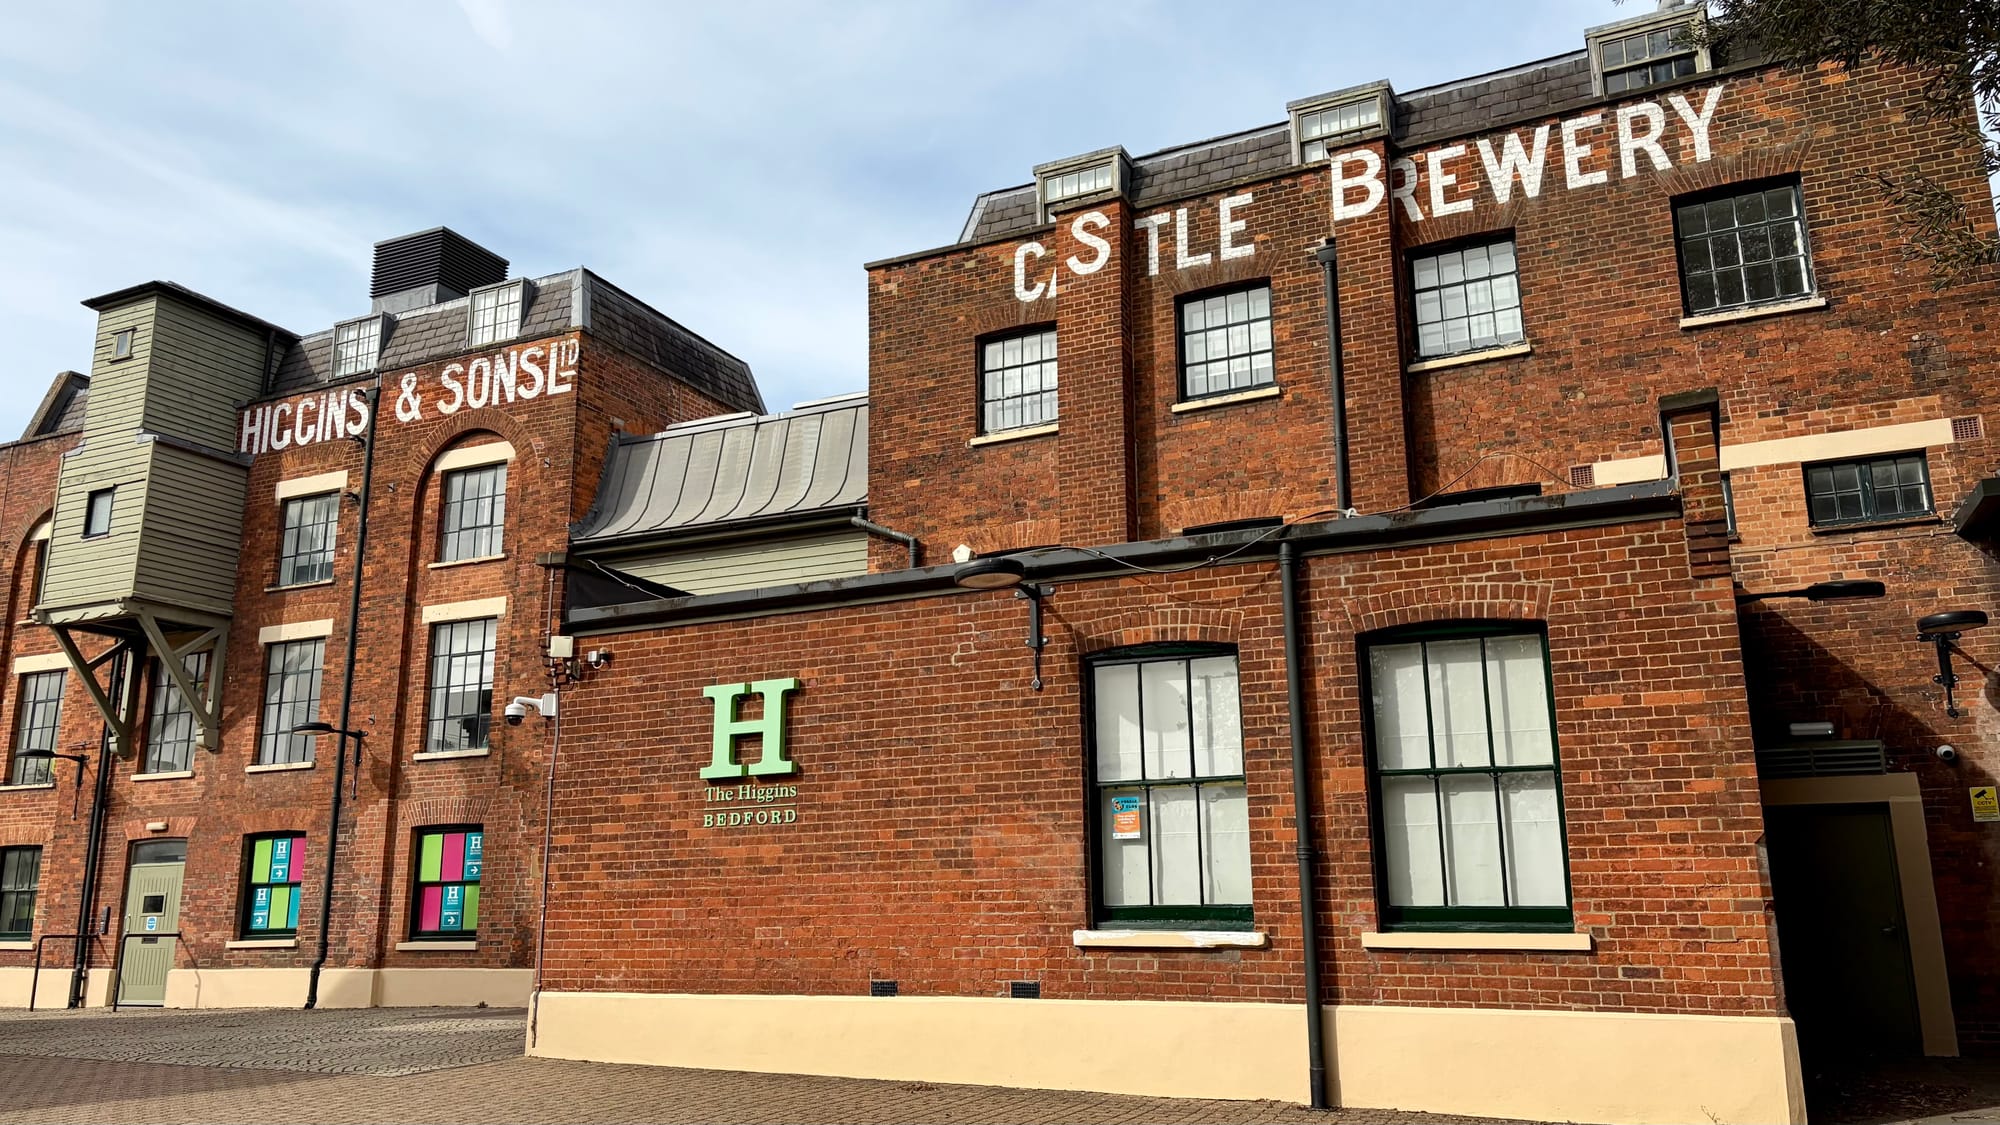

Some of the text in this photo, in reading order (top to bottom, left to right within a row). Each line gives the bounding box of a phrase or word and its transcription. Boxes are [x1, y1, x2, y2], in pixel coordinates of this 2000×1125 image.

[1013, 85, 1724, 303] CSTLE BREWERY
[239, 388, 370, 455] HIGGINS
[394, 372, 423, 423] &
[437, 351, 544, 414] SONS
[700, 677, 800, 780] H
[704, 783, 798, 803] The Higgins
[703, 809, 797, 828] BEDFORD
[276, 841, 288, 854] H
[470, 836, 482, 849] H
[256, 888, 268, 901] H
[447, 886, 459, 899] H
